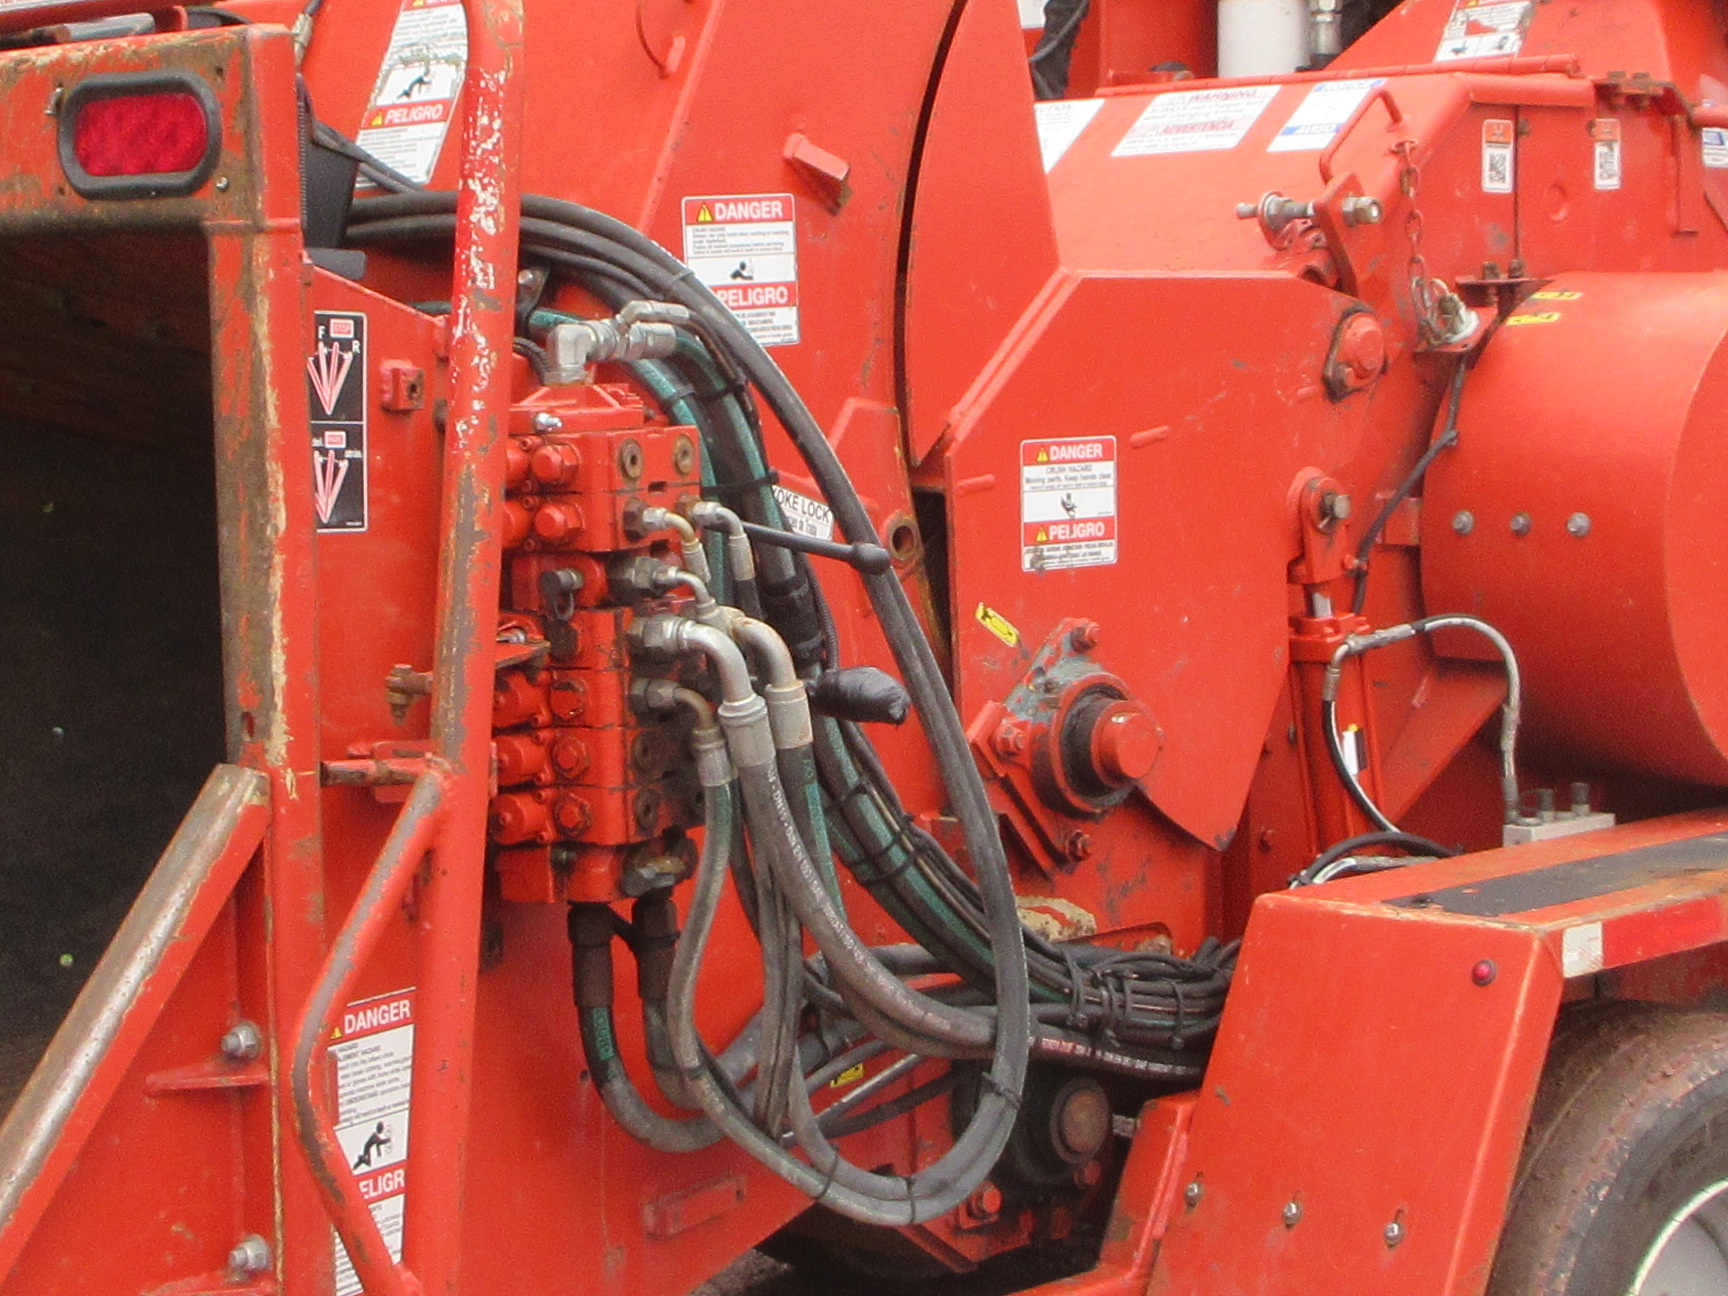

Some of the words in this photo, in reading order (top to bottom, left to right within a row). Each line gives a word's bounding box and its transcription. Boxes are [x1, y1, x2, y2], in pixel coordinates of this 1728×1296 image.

[1188, 88, 1258, 102] WARNING
[384, 103, 443, 124] PELIGRO
[1160, 120, 1235, 134] ADVERTENCIA
[714, 200, 783, 220] DANGER
[717, 286, 788, 306] PELIGRO
[318, 326, 326, 339] F
[352, 340, 361, 353] R
[1049, 443, 1103, 460] DANGER
[801, 499, 830, 524] LOCK
[1049, 522, 1105, 540] PELIGRO
[344, 1000, 411, 1034] DANGER
[358, 1169, 405, 1199] ELIGR
